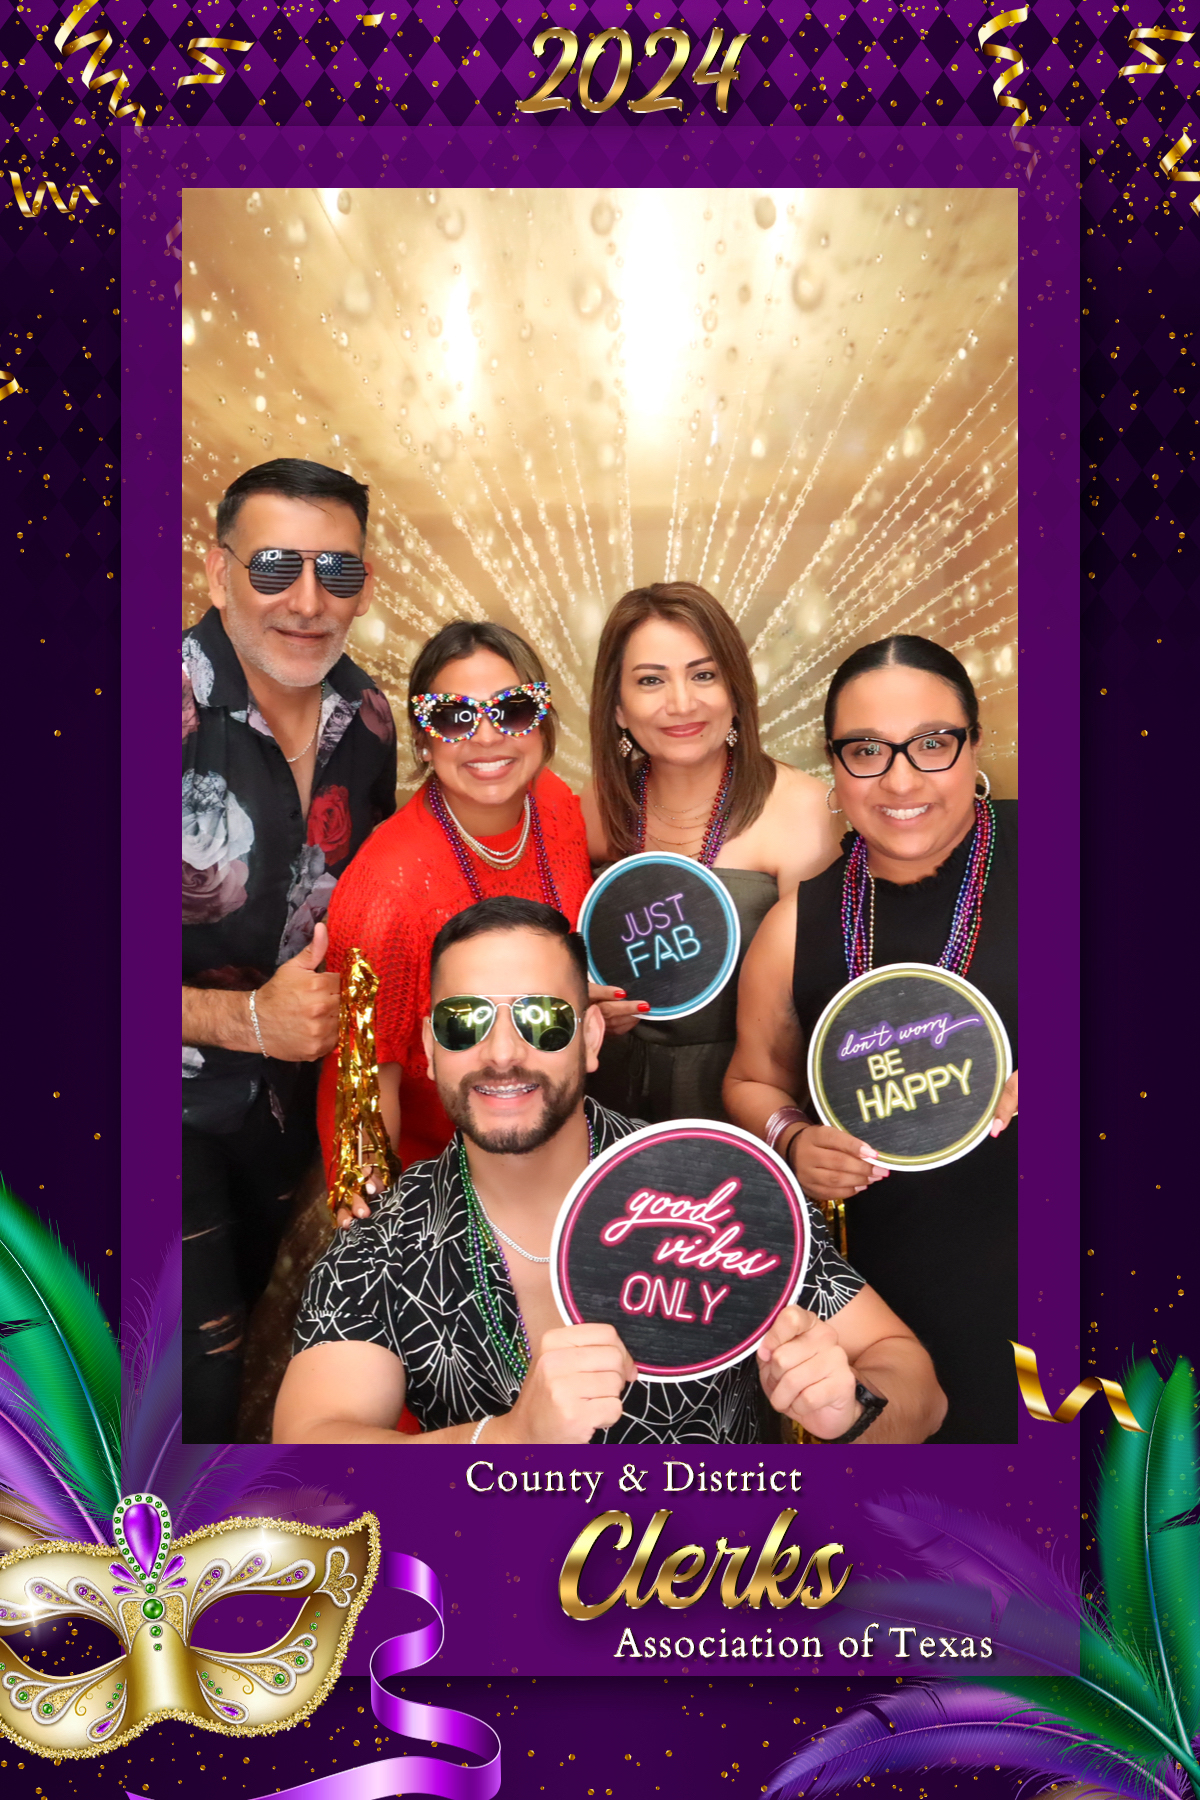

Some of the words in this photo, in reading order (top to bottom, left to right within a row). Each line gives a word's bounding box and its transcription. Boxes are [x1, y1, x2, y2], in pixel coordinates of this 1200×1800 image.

[620, 893, 684, 942] JUST
[625, 924, 702, 979] FAB
[840, 1025, 893, 1058] don't
[898, 1016, 981, 1046] worry
[856, 1058, 973, 1123] HAPPY
[867, 1048, 905, 1081] BE
[602, 1179, 738, 1244] good
[655, 1223, 779, 1277] vibes
[621, 1273, 730, 1323] ONLY
